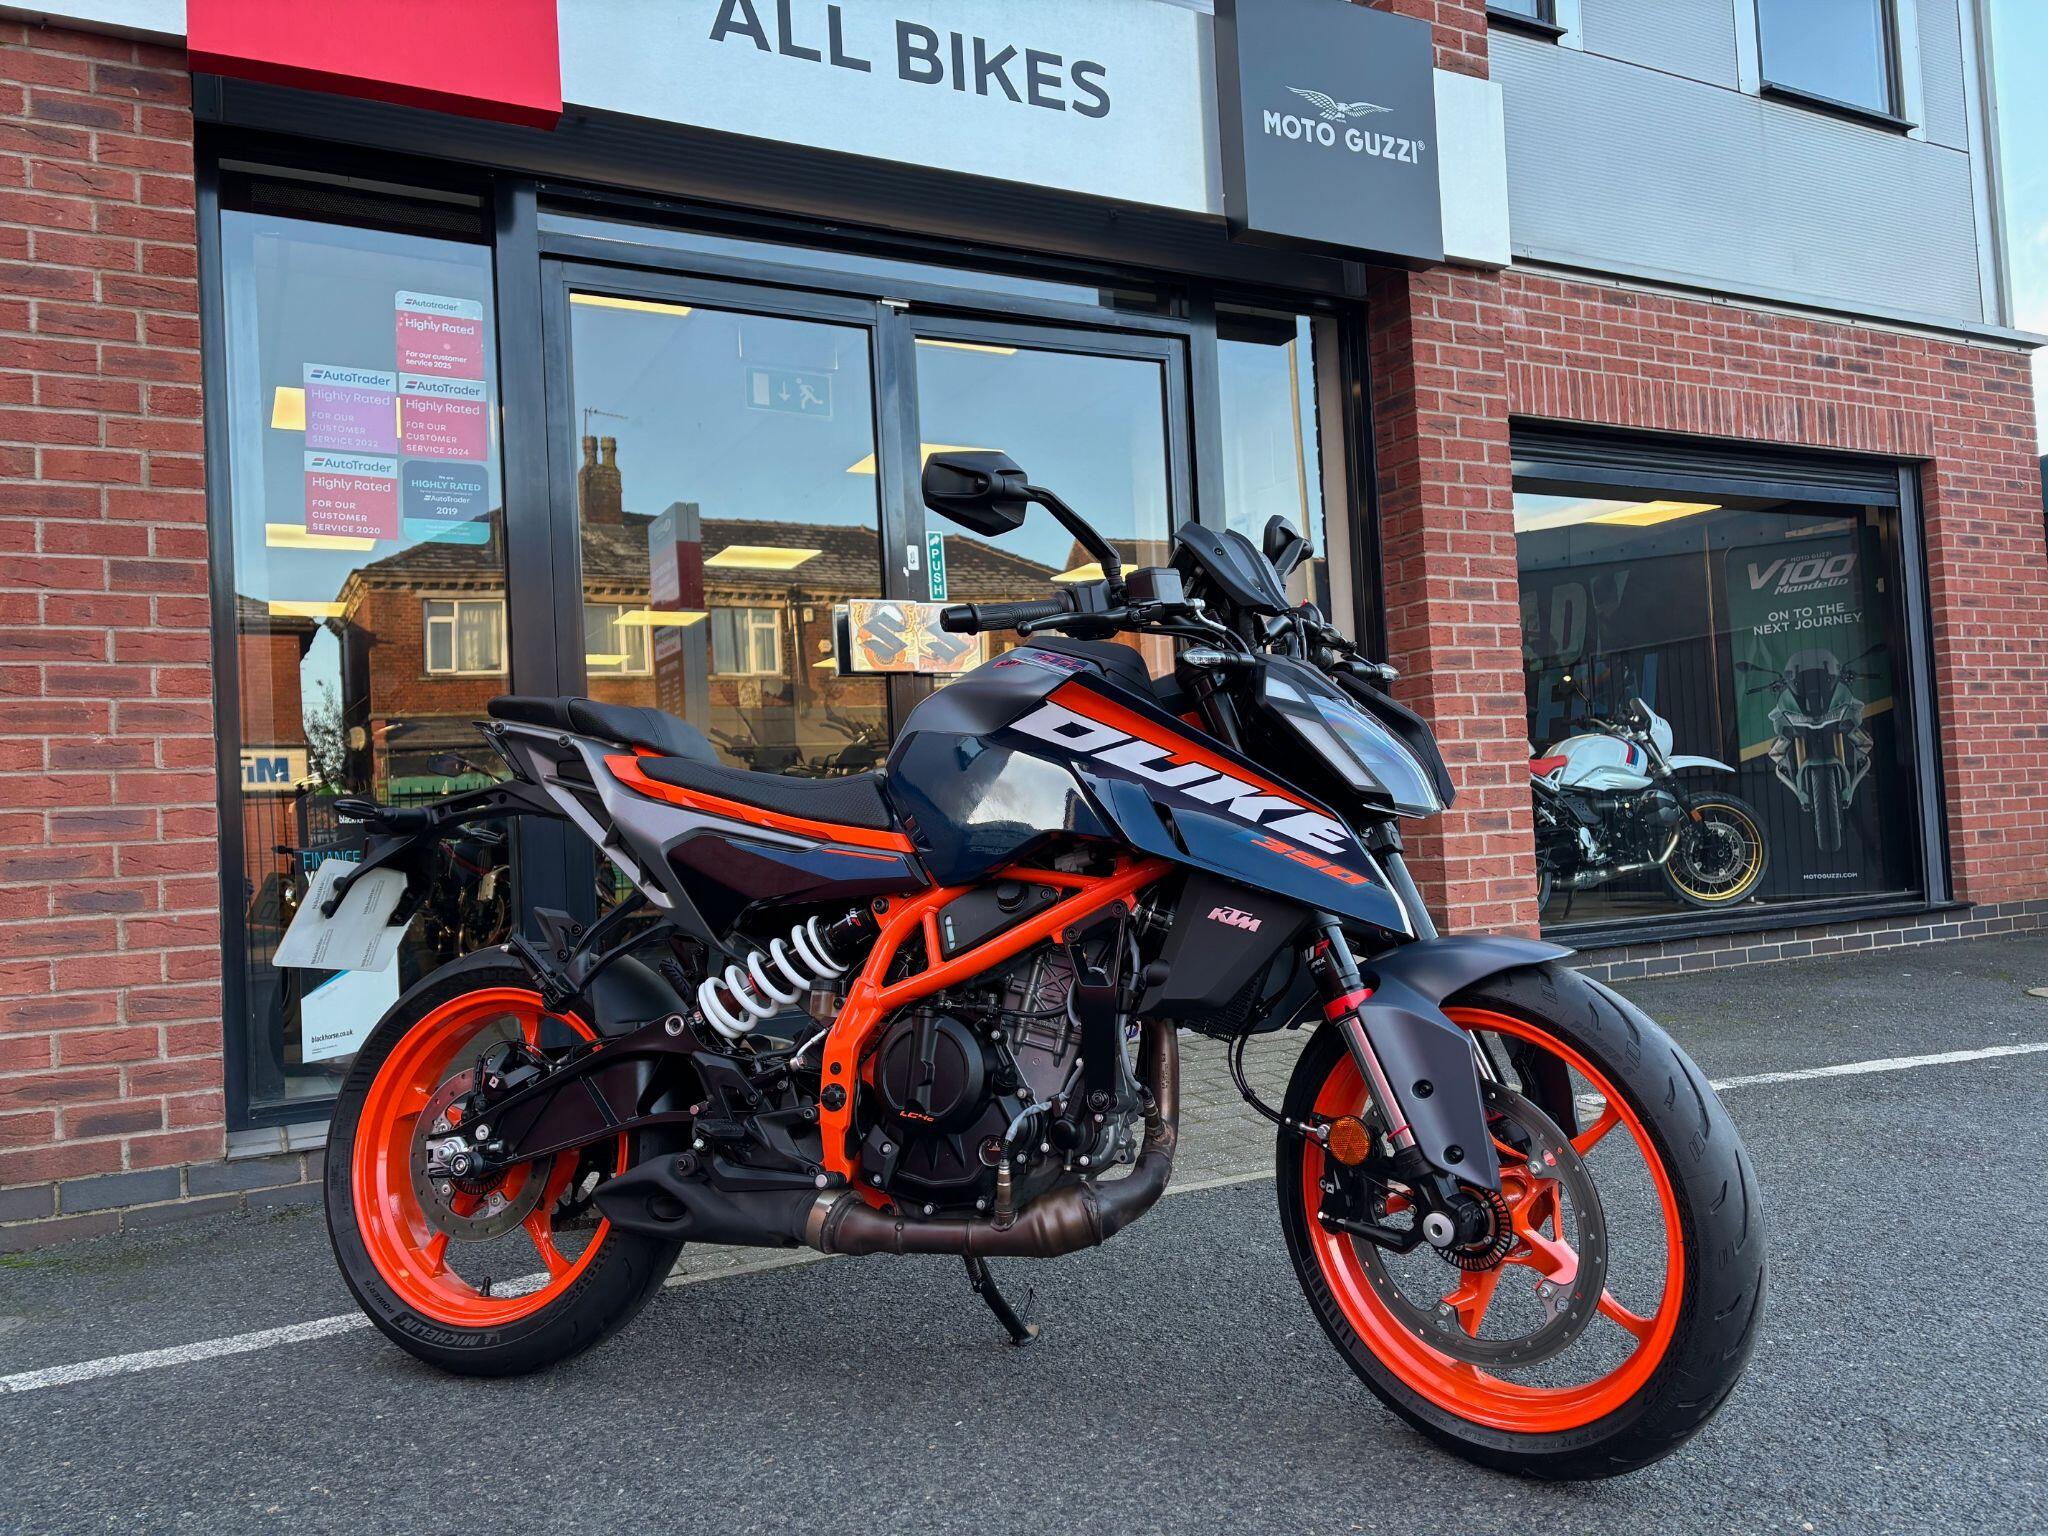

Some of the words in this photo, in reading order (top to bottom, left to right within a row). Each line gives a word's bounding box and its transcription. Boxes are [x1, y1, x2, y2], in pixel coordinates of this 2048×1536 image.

[709, 0, 872, 73] ALL
[895, 19, 1111, 119] BIKES
[1263, 109, 1336, 147] MOTO
[411, 299, 458, 311] Autotrader
[405, 318, 440, 333] Highly
[442, 323, 474, 335] Rated
[405, 350, 418, 358] For
[432, 354, 467, 363] customer
[405, 358, 433, 367] service
[433, 361, 452, 369] 2025
[323, 370, 391, 386] AutoTrader
[417, 381, 481, 396] AutoTrader
[311, 388, 352, 404] Highly
[353, 393, 391, 406] Rated
[405, 399, 443, 414] Highly
[445, 403, 480, 415] Rated
[311, 411, 332, 420] FOR
[334, 413, 354, 422] OUR
[311, 423, 366, 435] CUSTOMER
[406, 421, 425, 429] FOR
[426, 423, 447, 431] OUR
[311, 434, 354, 446] SERVICE
[406, 432, 457, 443] CUSTOMER
[406, 444, 445, 454] SERVICE
[447, 447, 469, 456] 2024
[324, 458, 392, 473] AutoTrader
[312, 476, 352, 491] Highly
[354, 480, 391, 493] Rated
[411, 480, 448, 489] HIGHLY
[449, 482, 481, 491] RATED
[312, 499, 332, 508] FOR
[334, 501, 356, 509] OUR
[430, 495, 470, 503] AutoTrader
[312, 511, 368, 522] CUSTOMER
[436, 507, 458, 515] 2019
[312, 522, 354, 533] SERVICE
[356, 526, 381, 535] 2020
[931, 549, 944, 595] PUSH
[1747, 553, 1858, 590] V100
[1774, 577, 1849, 595] Mandello
[1768, 610, 1789, 622] ON
[1793, 607, 1813, 618] TO
[1816, 602, 1845, 615] THE
[1753, 621, 1790, 636] NEXT
[1794, 612, 1862, 630] JOURNEY
[1008, 700, 1352, 854] DUKE
[1251, 834, 1370, 885] 390
[1207, 906, 1262, 933] KTM
[399, 1317, 481, 1346] MICHELIN
